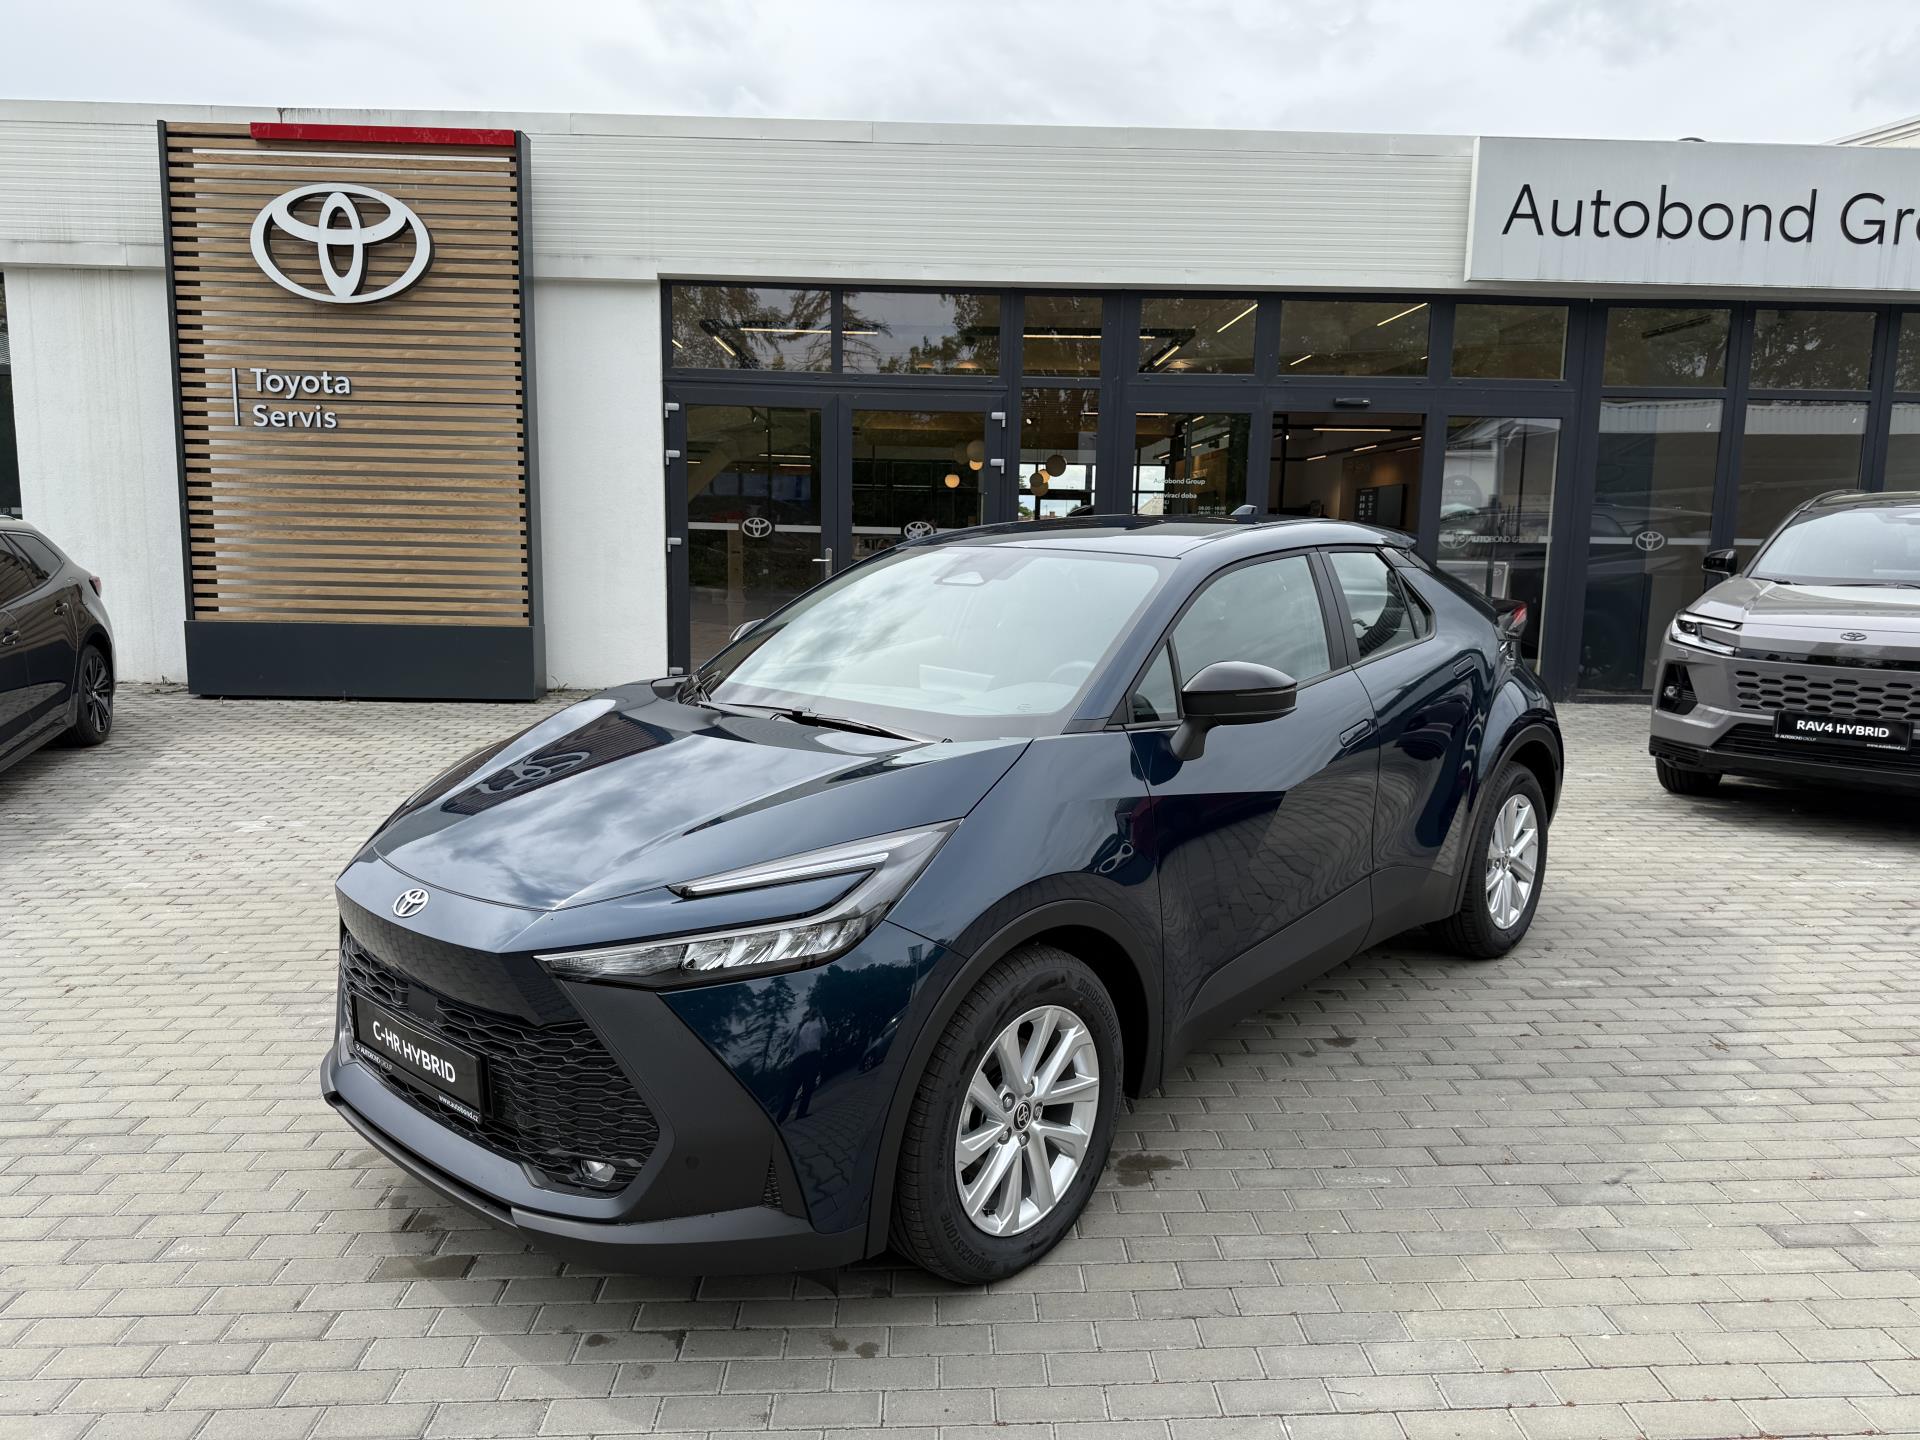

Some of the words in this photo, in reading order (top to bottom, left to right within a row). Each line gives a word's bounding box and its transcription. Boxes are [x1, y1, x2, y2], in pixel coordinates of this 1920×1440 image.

[1502, 184, 1817, 243] Autobond
[1840, 192, 1920, 245] Gr
[250, 368, 350, 399] Toyota
[253, 405, 337, 428] Servis
[1185, 478, 1206, 486] Group
[1796, 720, 1833, 733] RAV4
[1836, 724, 1889, 738] HYBRID
[1866, 743, 1906, 751] www.autobond.cz
[372, 1021, 402, 1055] C-HR
[402, 1039, 456, 1083] HYBRID
[438, 1094, 479, 1122] www.autobond.cz
